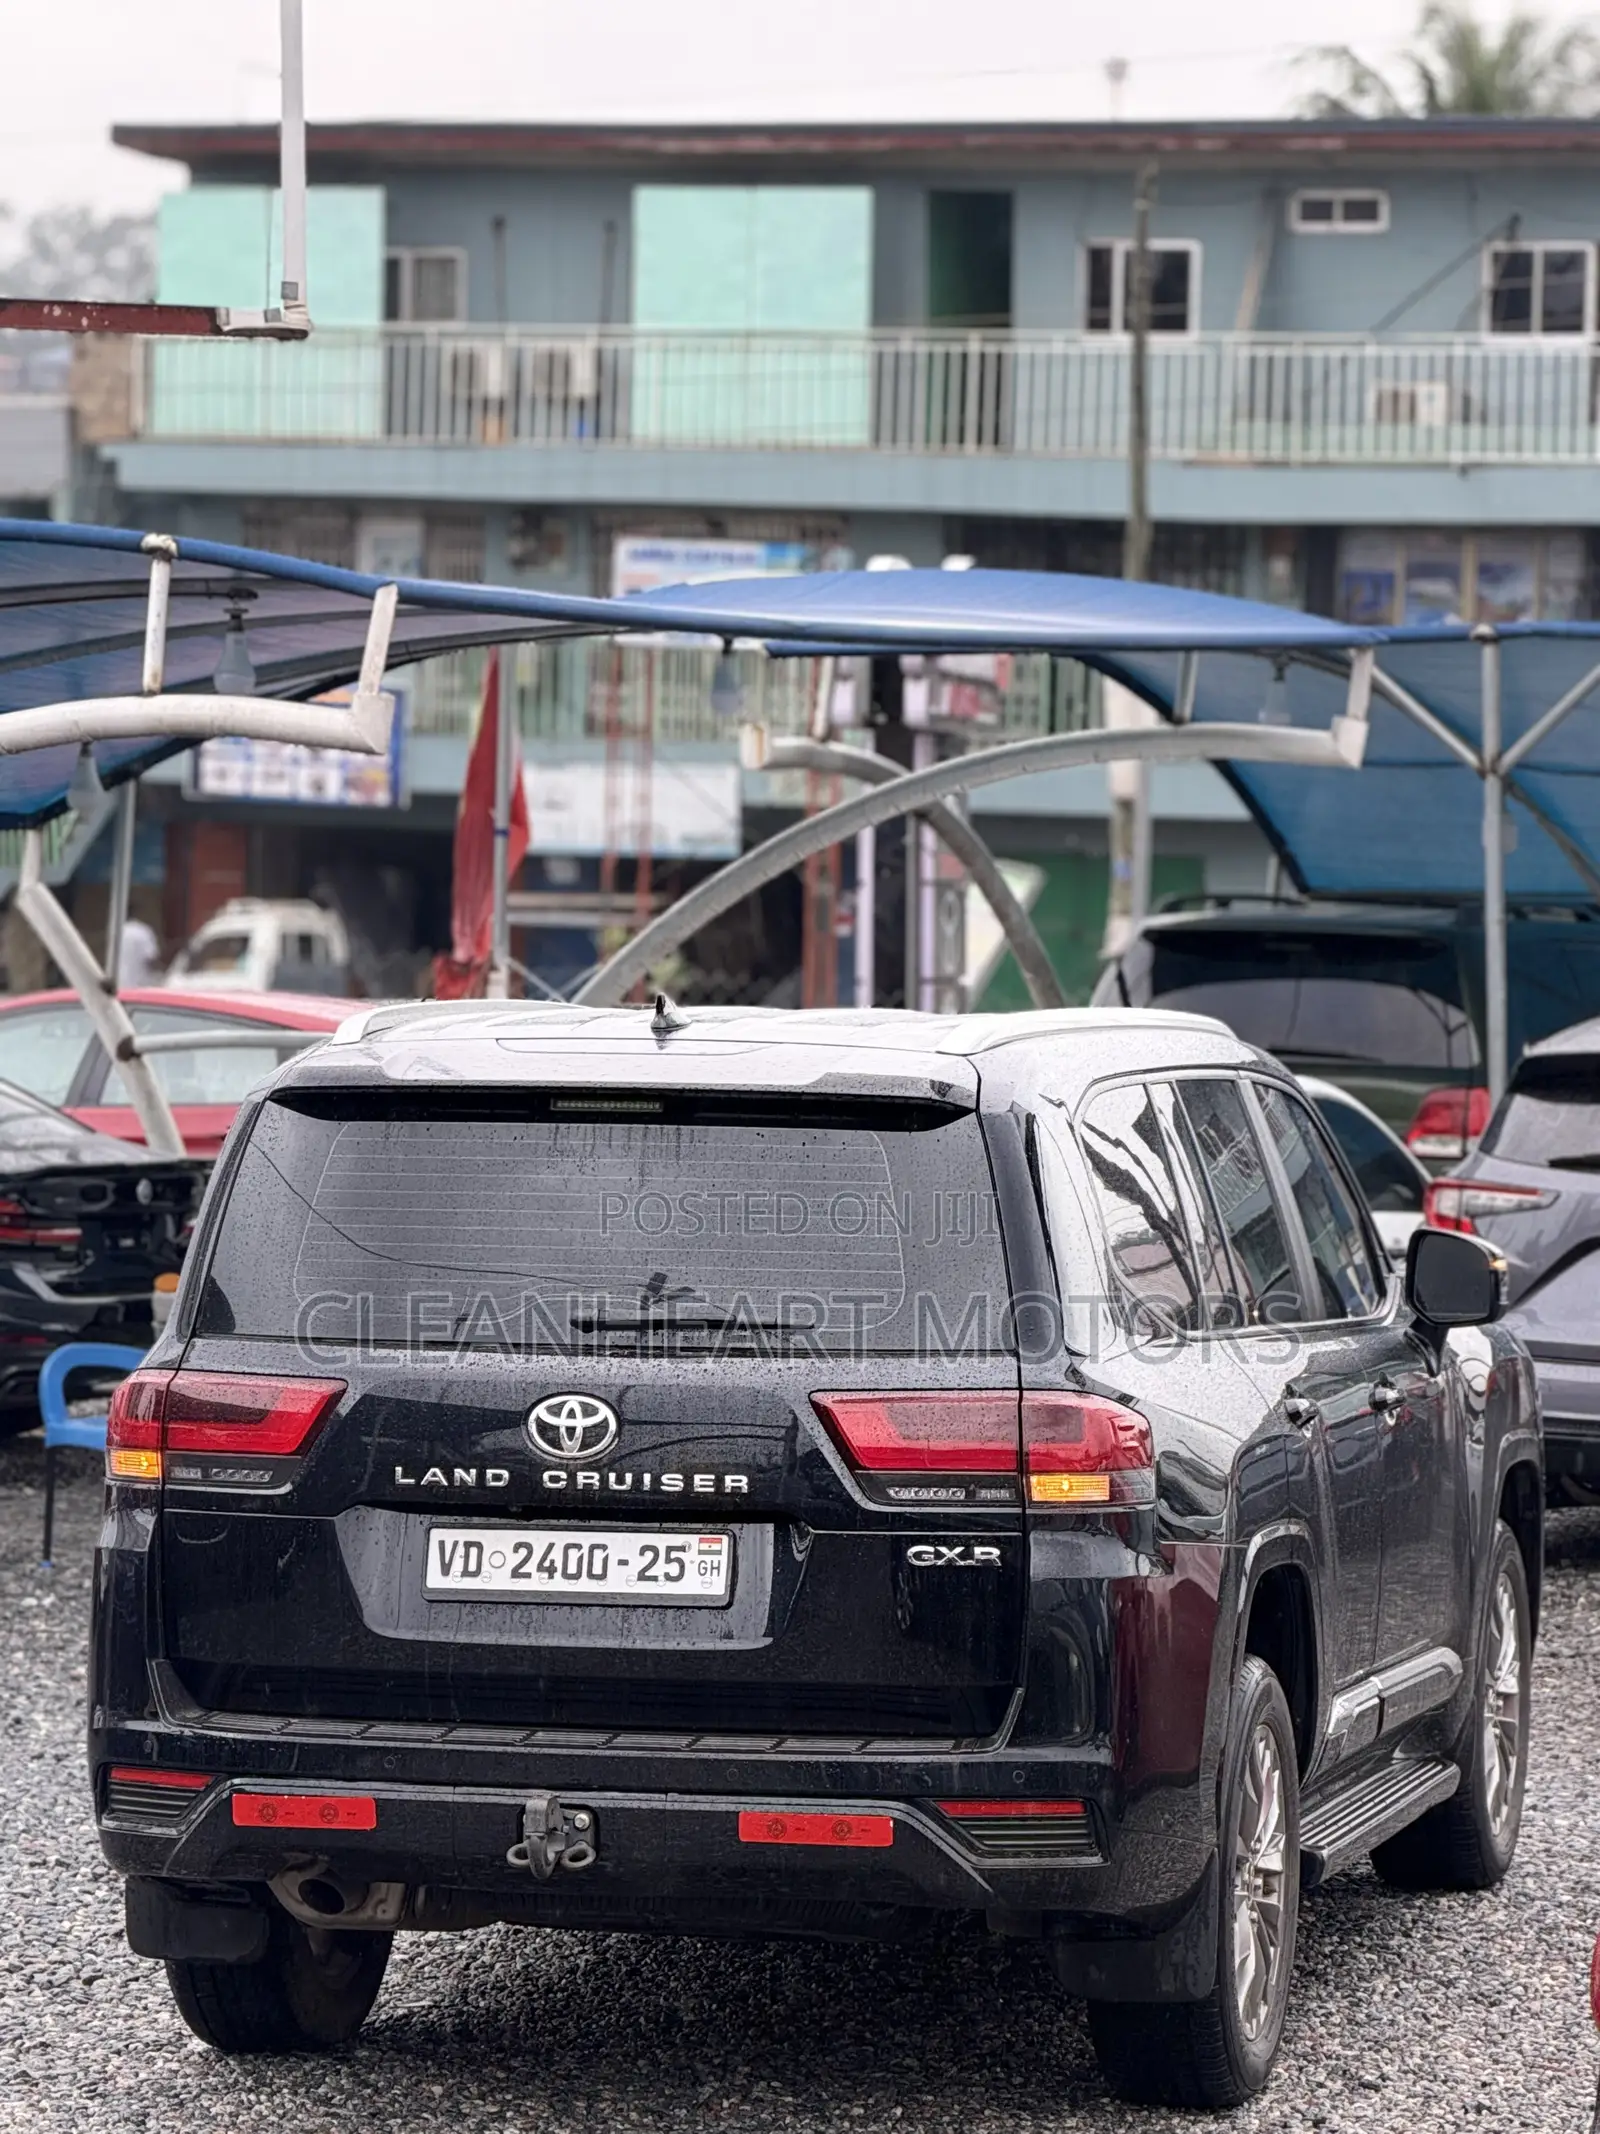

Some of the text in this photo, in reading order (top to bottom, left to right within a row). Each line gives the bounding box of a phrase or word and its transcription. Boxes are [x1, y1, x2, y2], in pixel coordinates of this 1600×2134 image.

[395, 1467, 749, 1494] LAND CRUISER
[438, 1539, 484, 1578] VD
[697, 1559, 721, 1577] GH
